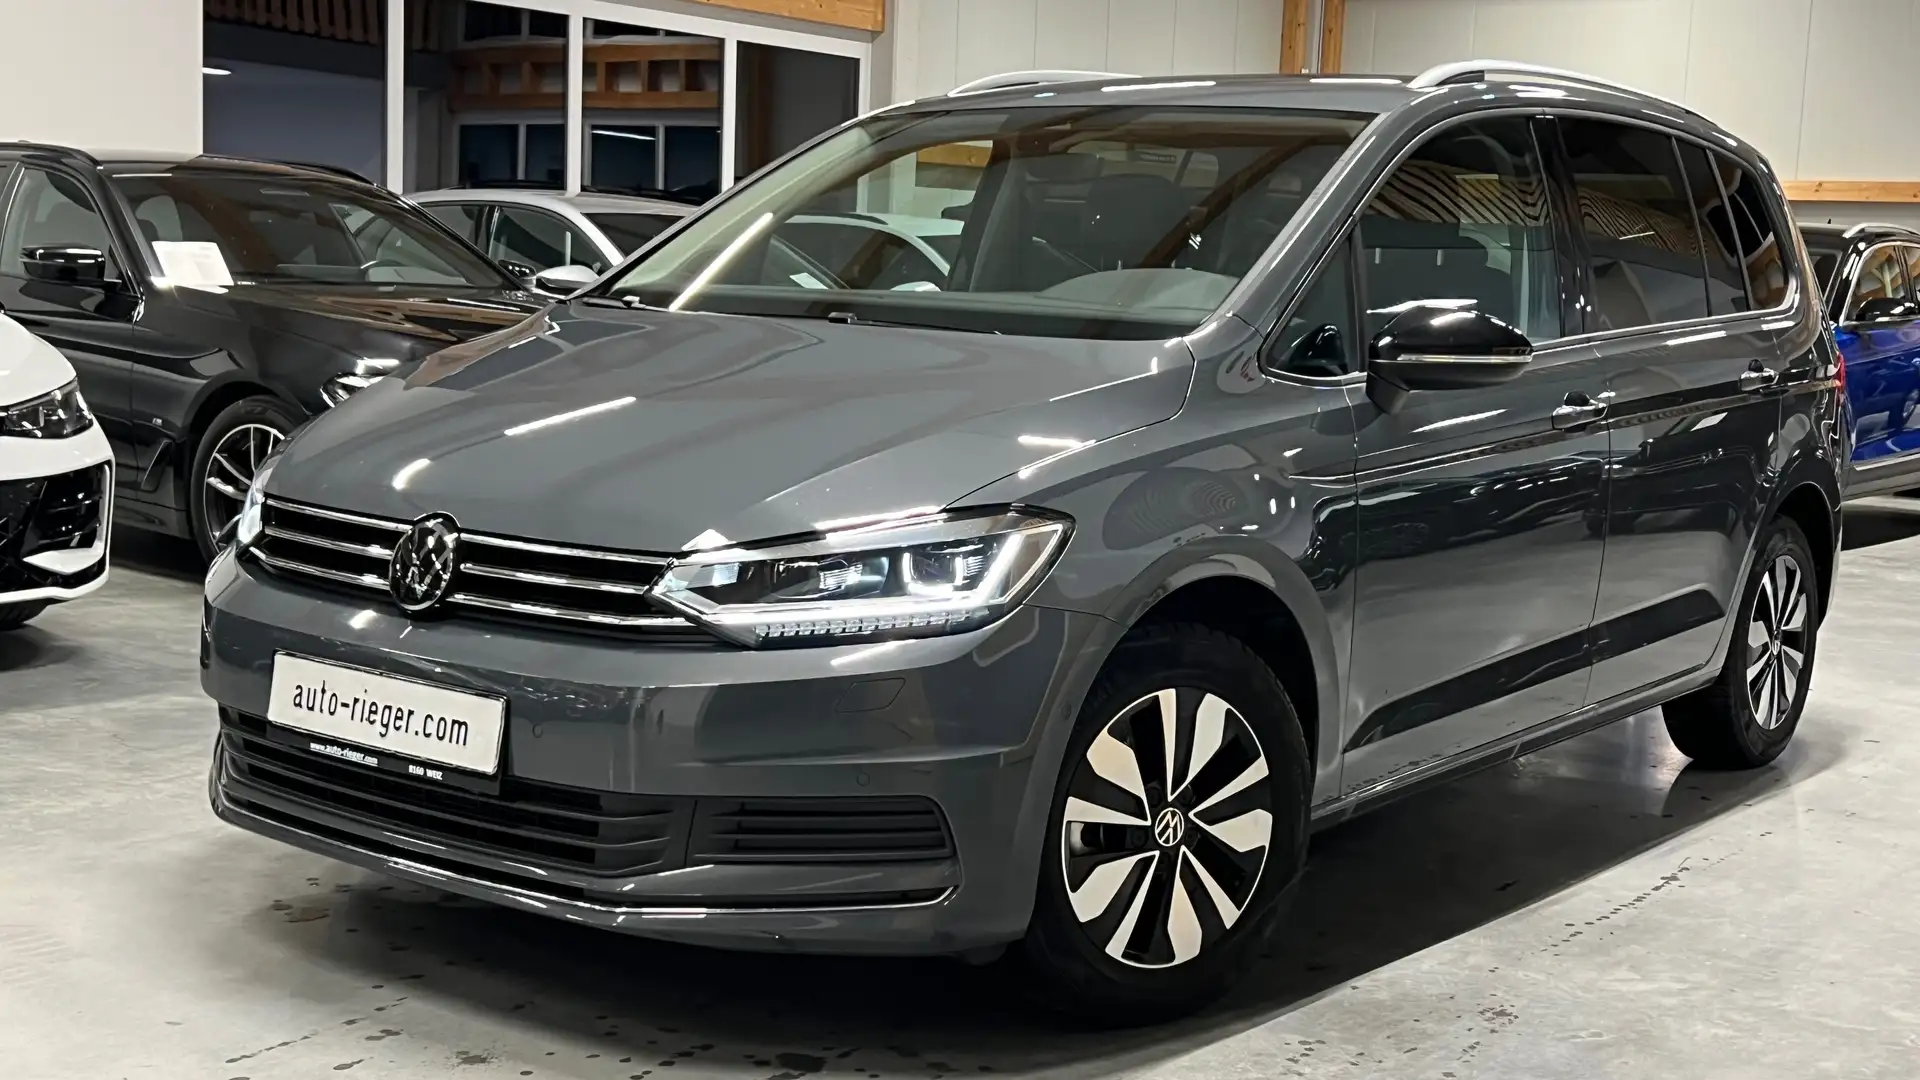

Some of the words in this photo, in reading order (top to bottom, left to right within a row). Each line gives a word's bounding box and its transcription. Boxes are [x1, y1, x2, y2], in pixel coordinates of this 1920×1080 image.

[293, 680, 468, 746] auto-rieger.com
[310, 742, 378, 766] www.auto-rieger.com
[426, 768, 443, 780] WEIZ
